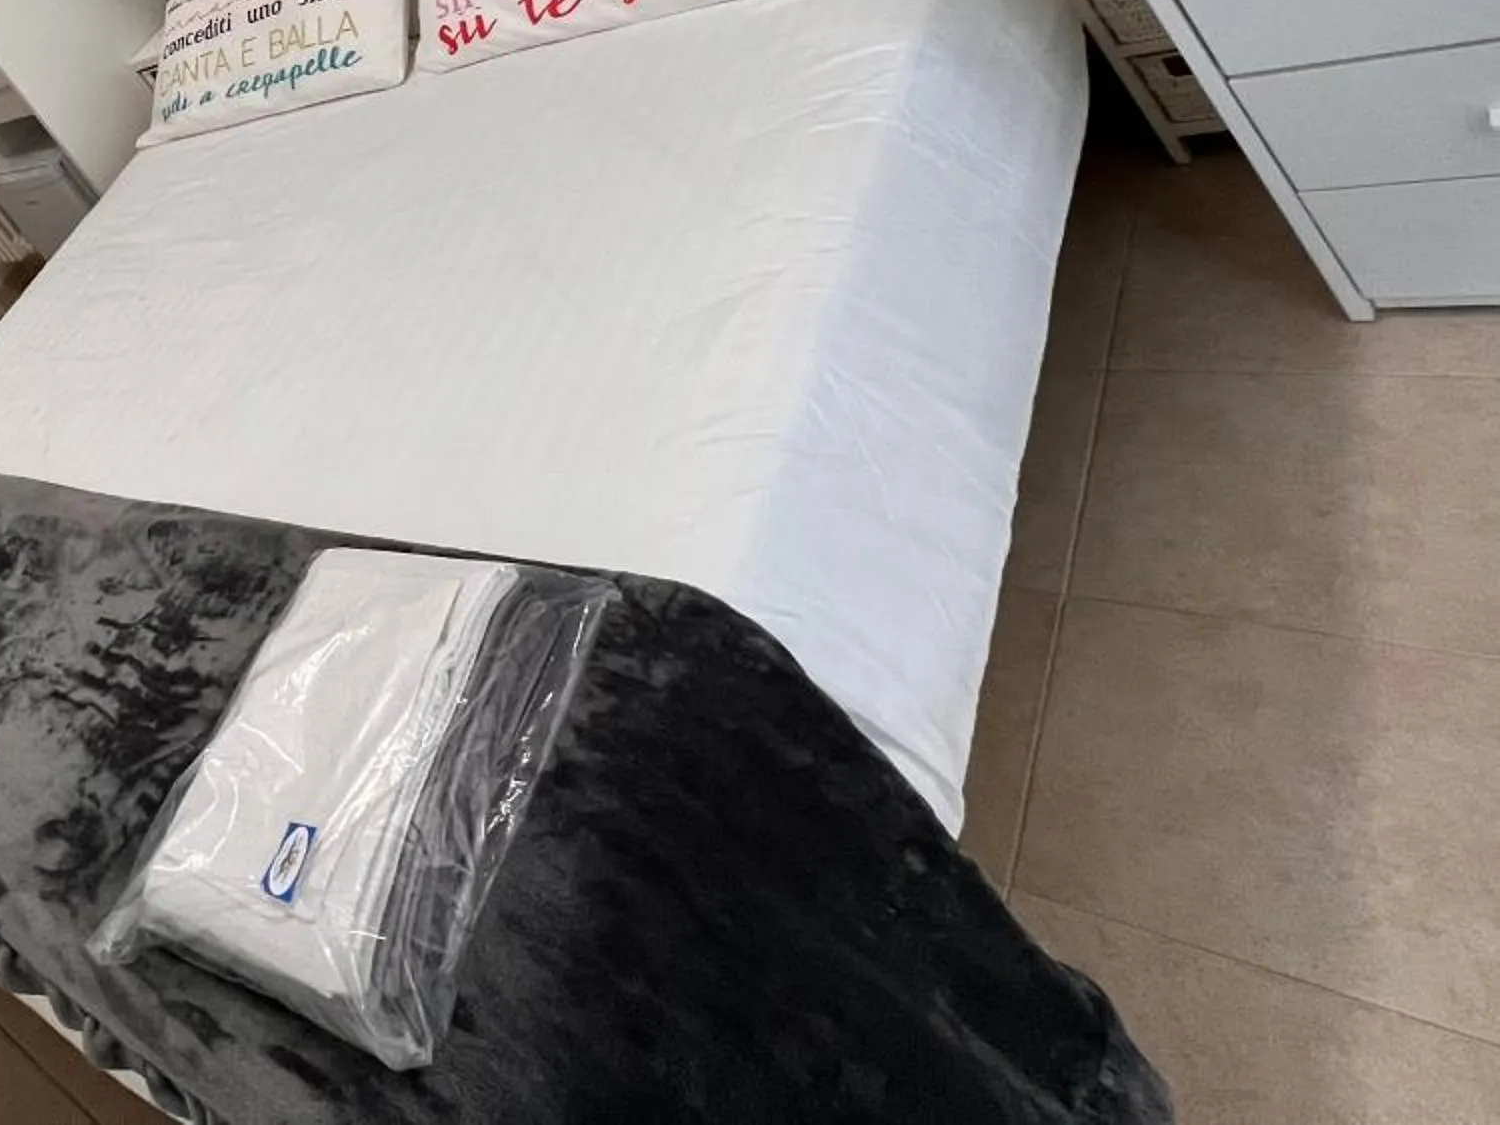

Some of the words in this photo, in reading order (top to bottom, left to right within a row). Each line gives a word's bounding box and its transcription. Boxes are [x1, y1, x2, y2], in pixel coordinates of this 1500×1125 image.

[163, 13, 232, 60] concediti
[247, 0, 283, 24] uno
[240, 36, 258, 68] E
[268, 9, 360, 61] BALLA
[438, 14, 498, 56] su
